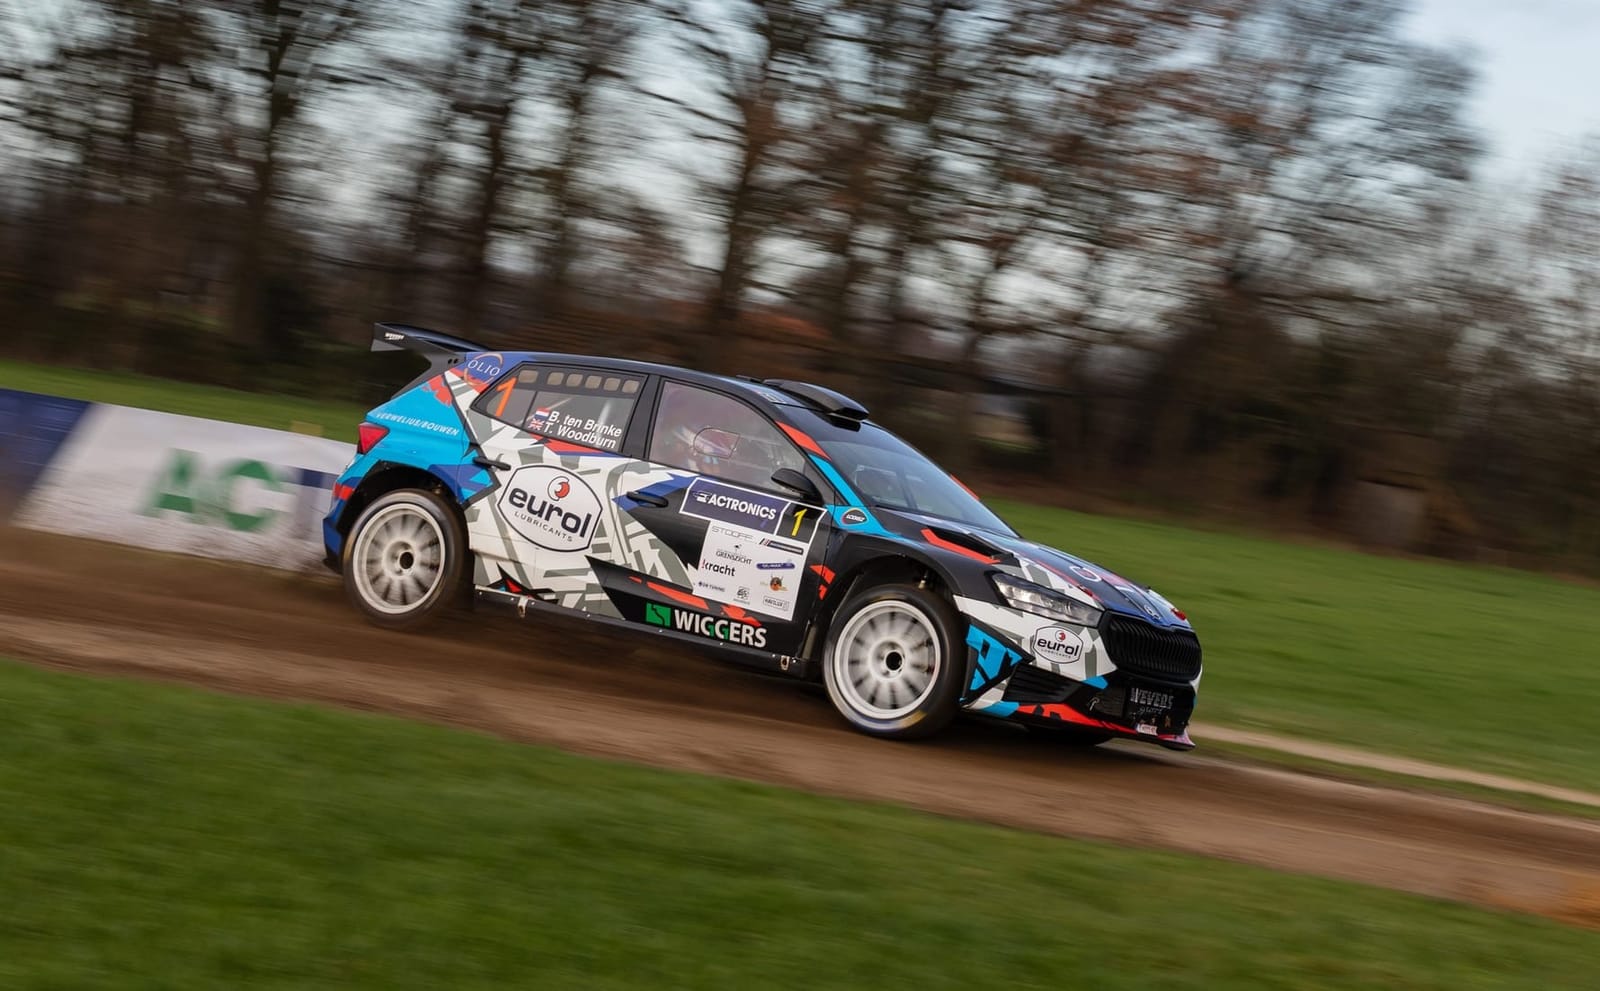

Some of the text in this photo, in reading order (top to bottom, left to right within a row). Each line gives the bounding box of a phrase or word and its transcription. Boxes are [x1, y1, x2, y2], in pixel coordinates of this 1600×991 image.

[467, 359, 501, 378] OLIO
[495, 376, 518, 417] 1
[543, 422, 617, 449] T. Woodburn
[548, 411, 622, 438] B. ten Brinke
[508, 487, 593, 538] eurol
[708, 495, 777, 519] ACTRONICS
[514, 511, 573, 542] LUBRICANTS
[791, 508, 808, 537] 1
[674, 609, 767, 649] WIGGERS
[1037, 638, 1080, 657] eurol
